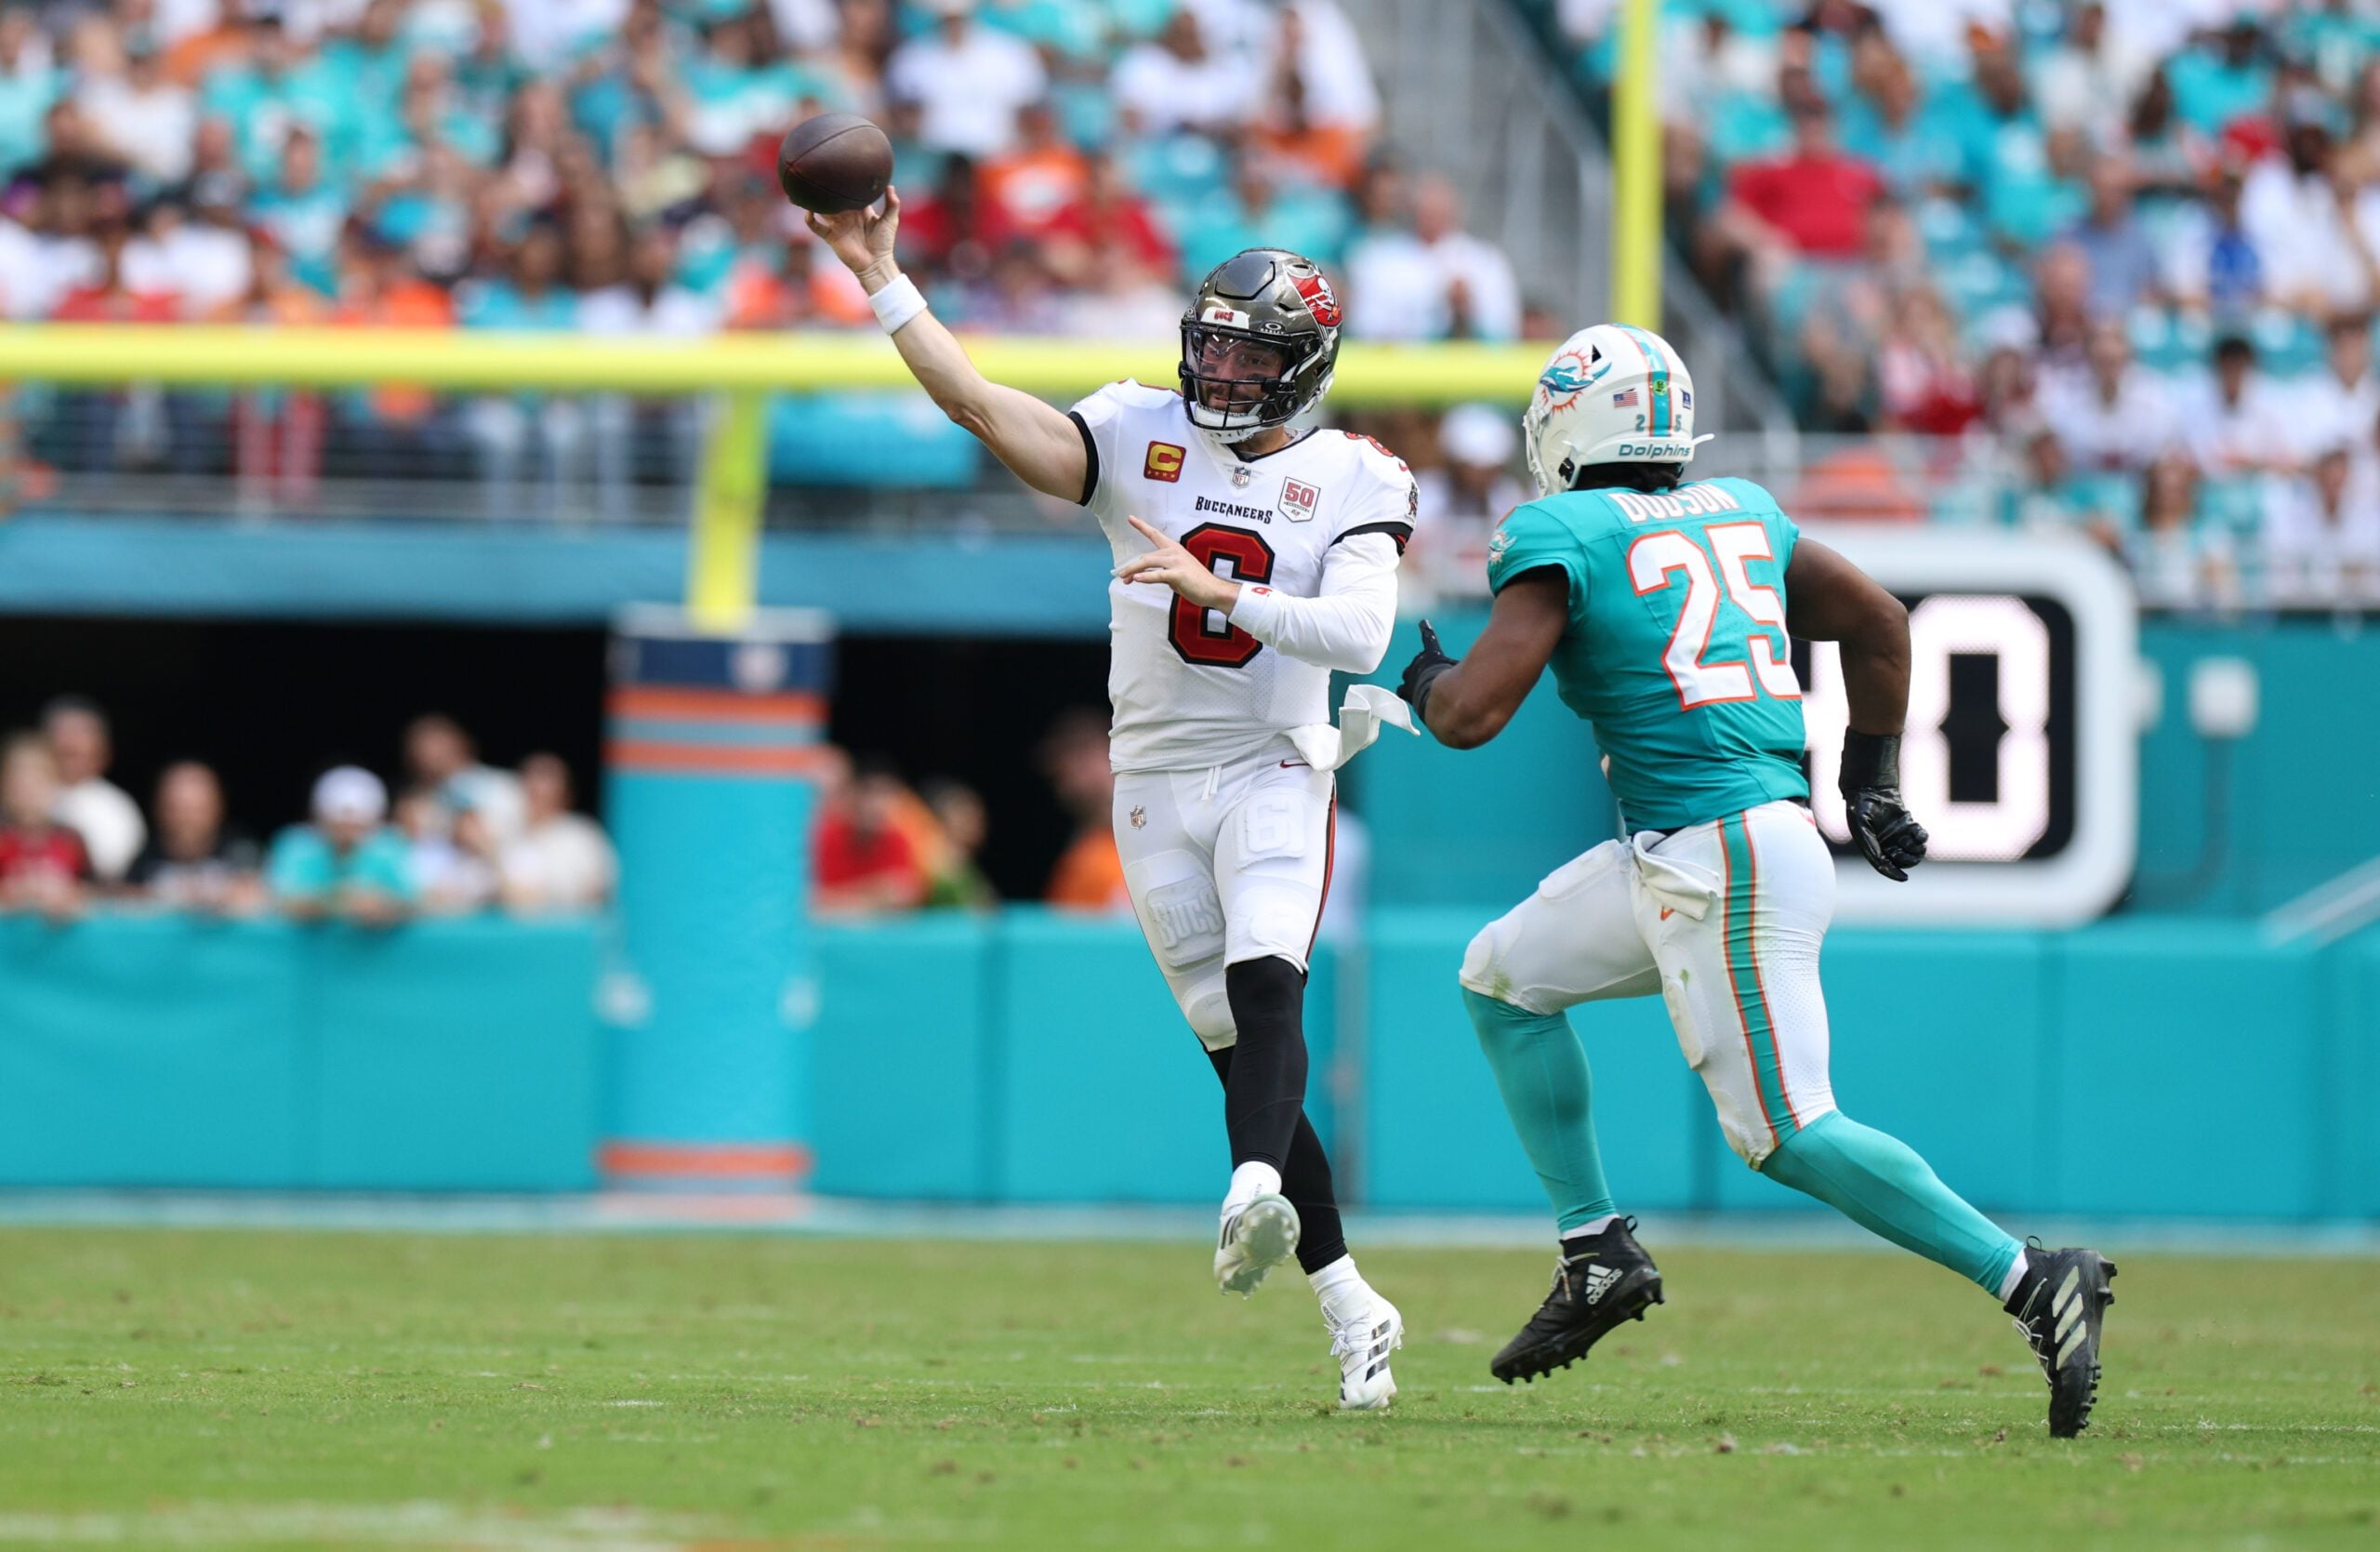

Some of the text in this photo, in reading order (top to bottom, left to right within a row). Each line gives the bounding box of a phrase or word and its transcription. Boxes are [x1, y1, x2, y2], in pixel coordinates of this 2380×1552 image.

[1635, 414, 1682, 431] 2 5
[1148, 444, 1183, 472] C
[1619, 444, 1691, 459] Dolphins
[1285, 482, 1316, 508] 50
[1607, 484, 1741, 523] DODSON
[1168, 522, 1276, 669] 6
[1626, 521, 1803, 712] 25
[1803, 594, 2050, 863] 0
[1587, 1268, 1623, 1305] adidas
